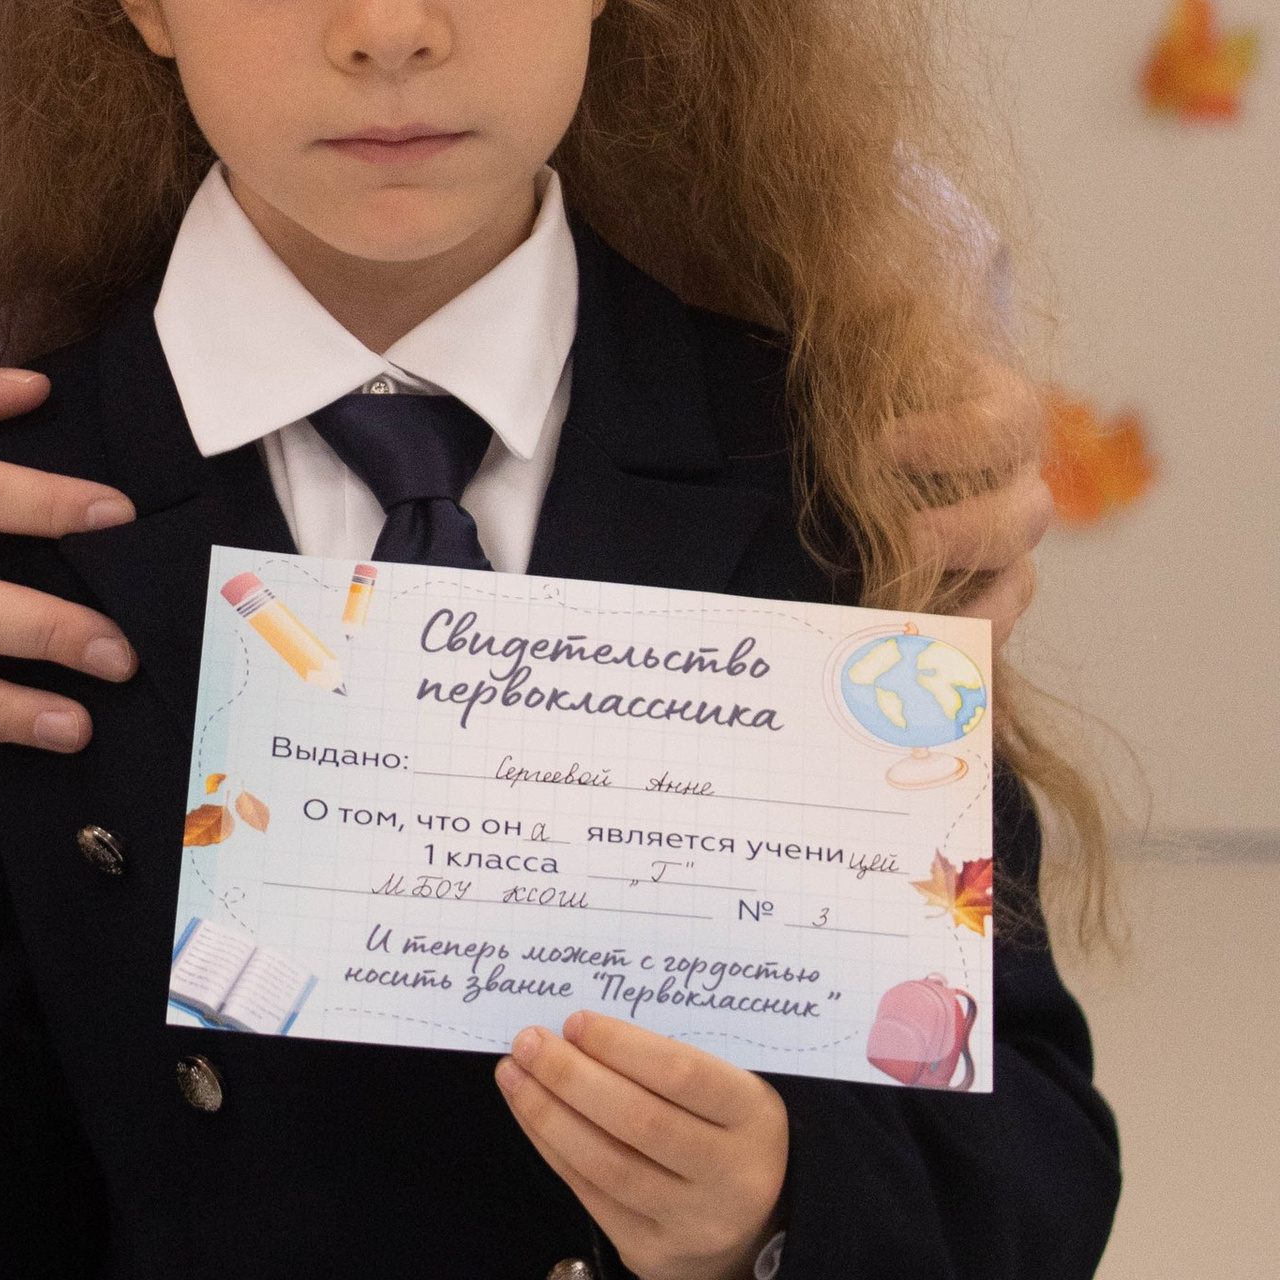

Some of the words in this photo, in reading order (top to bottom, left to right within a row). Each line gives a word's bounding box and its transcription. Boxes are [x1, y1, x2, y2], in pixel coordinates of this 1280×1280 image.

[420, 608, 770, 681] Свидетельство
[417, 666, 785, 730] первоклассника
[271, 735, 409, 770] Выдано:
[495, 754, 612, 787] Сергеевой
[645, 771, 715, 797] Анне
[303, 799, 328, 820] О
[338, 808, 405, 832] том,
[417, 814, 470, 833] что
[587, 826, 735, 854] является
[424, 844, 435, 865] 1
[447, 850, 559, 874] класса
[738, 899, 774, 921] №
[812, 907, 829, 927] 3
[344, 967, 453, 990] носить
[462, 963, 574, 1003] звание
[366, 923, 391, 953] И
[402, 935, 510, 970] теперь
[522, 945, 632, 967] может
[640, 954, 655, 970] с
[663, 956, 820, 991] гордостью
